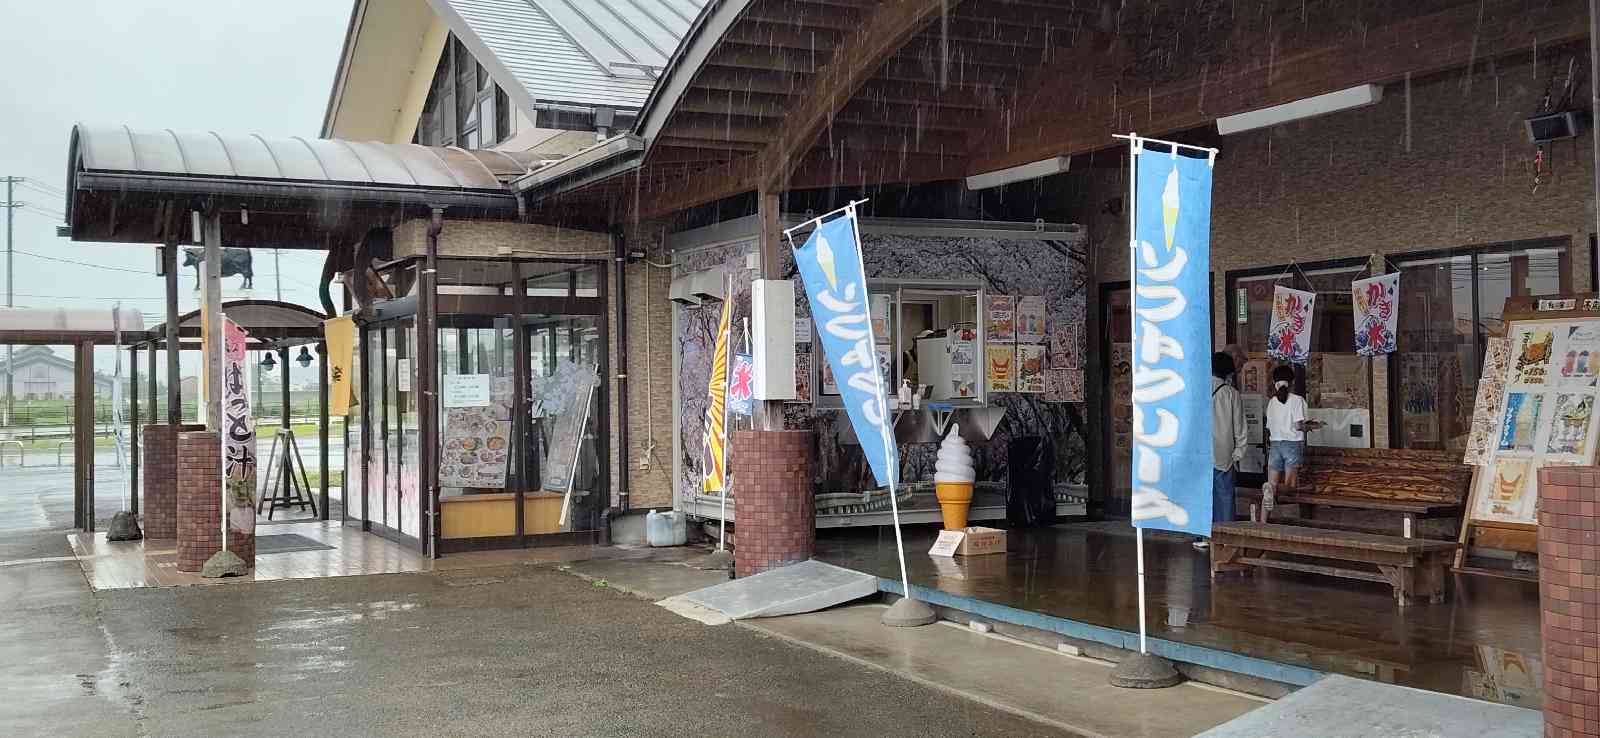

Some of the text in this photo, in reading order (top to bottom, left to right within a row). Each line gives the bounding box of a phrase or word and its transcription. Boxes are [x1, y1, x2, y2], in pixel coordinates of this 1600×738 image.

[1366, 282, 1392, 352] かき氷
[224, 362, 257, 480] はっと汁
[1135, 240, 1188, 526] ソフトクリーム
